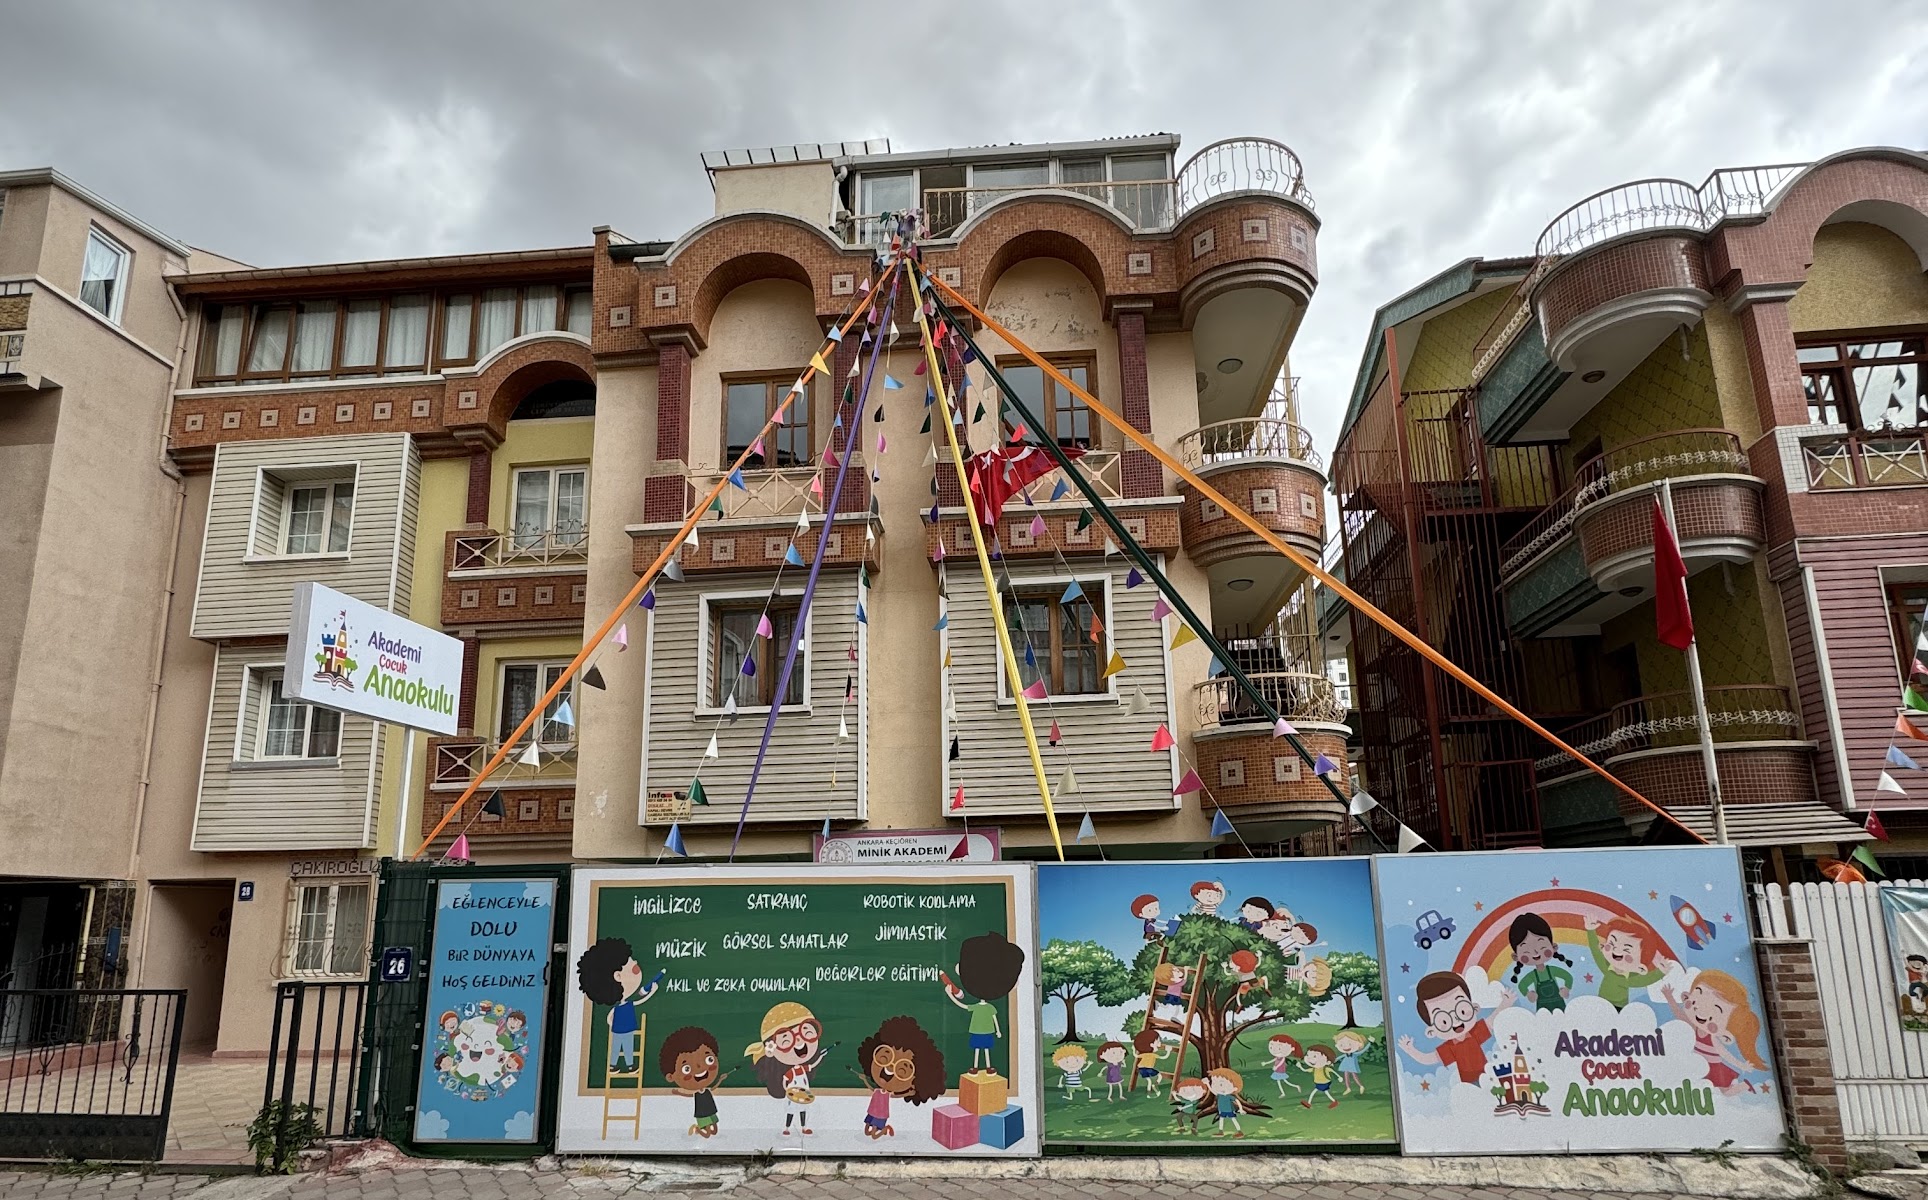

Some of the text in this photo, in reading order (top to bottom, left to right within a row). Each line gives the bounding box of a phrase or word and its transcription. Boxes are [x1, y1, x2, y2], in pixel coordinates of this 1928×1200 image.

[367, 630, 422, 664] Akademi
[379, 654, 408, 675] Çocuk
[363, 664, 454, 717] Anaokulu
[857, 845, 948, 858] MİNİK AKADEMİ
[452, 893, 541, 910] EĞLENCEYLE
[747, 892, 808, 912] SATRANÇ
[863, 892, 977, 909] ROBOTİK KODLAMA
[470, 920, 518, 937] DOLU
[874, 922, 948, 942] JİMNASTİK
[655, 937, 708, 959] MÜZİK
[722, 931, 849, 950] GÖRSEL SANATLAR
[473, 944, 536, 962] DÜNYAYA
[388, 957, 406, 975] 26
[665, 977, 692, 993] AKIL
[1554, 1027, 1666, 1058] Akademi
[1581, 1057, 1642, 1086] Çocuk
[1562, 1078, 1715, 1118] Anaokulu
